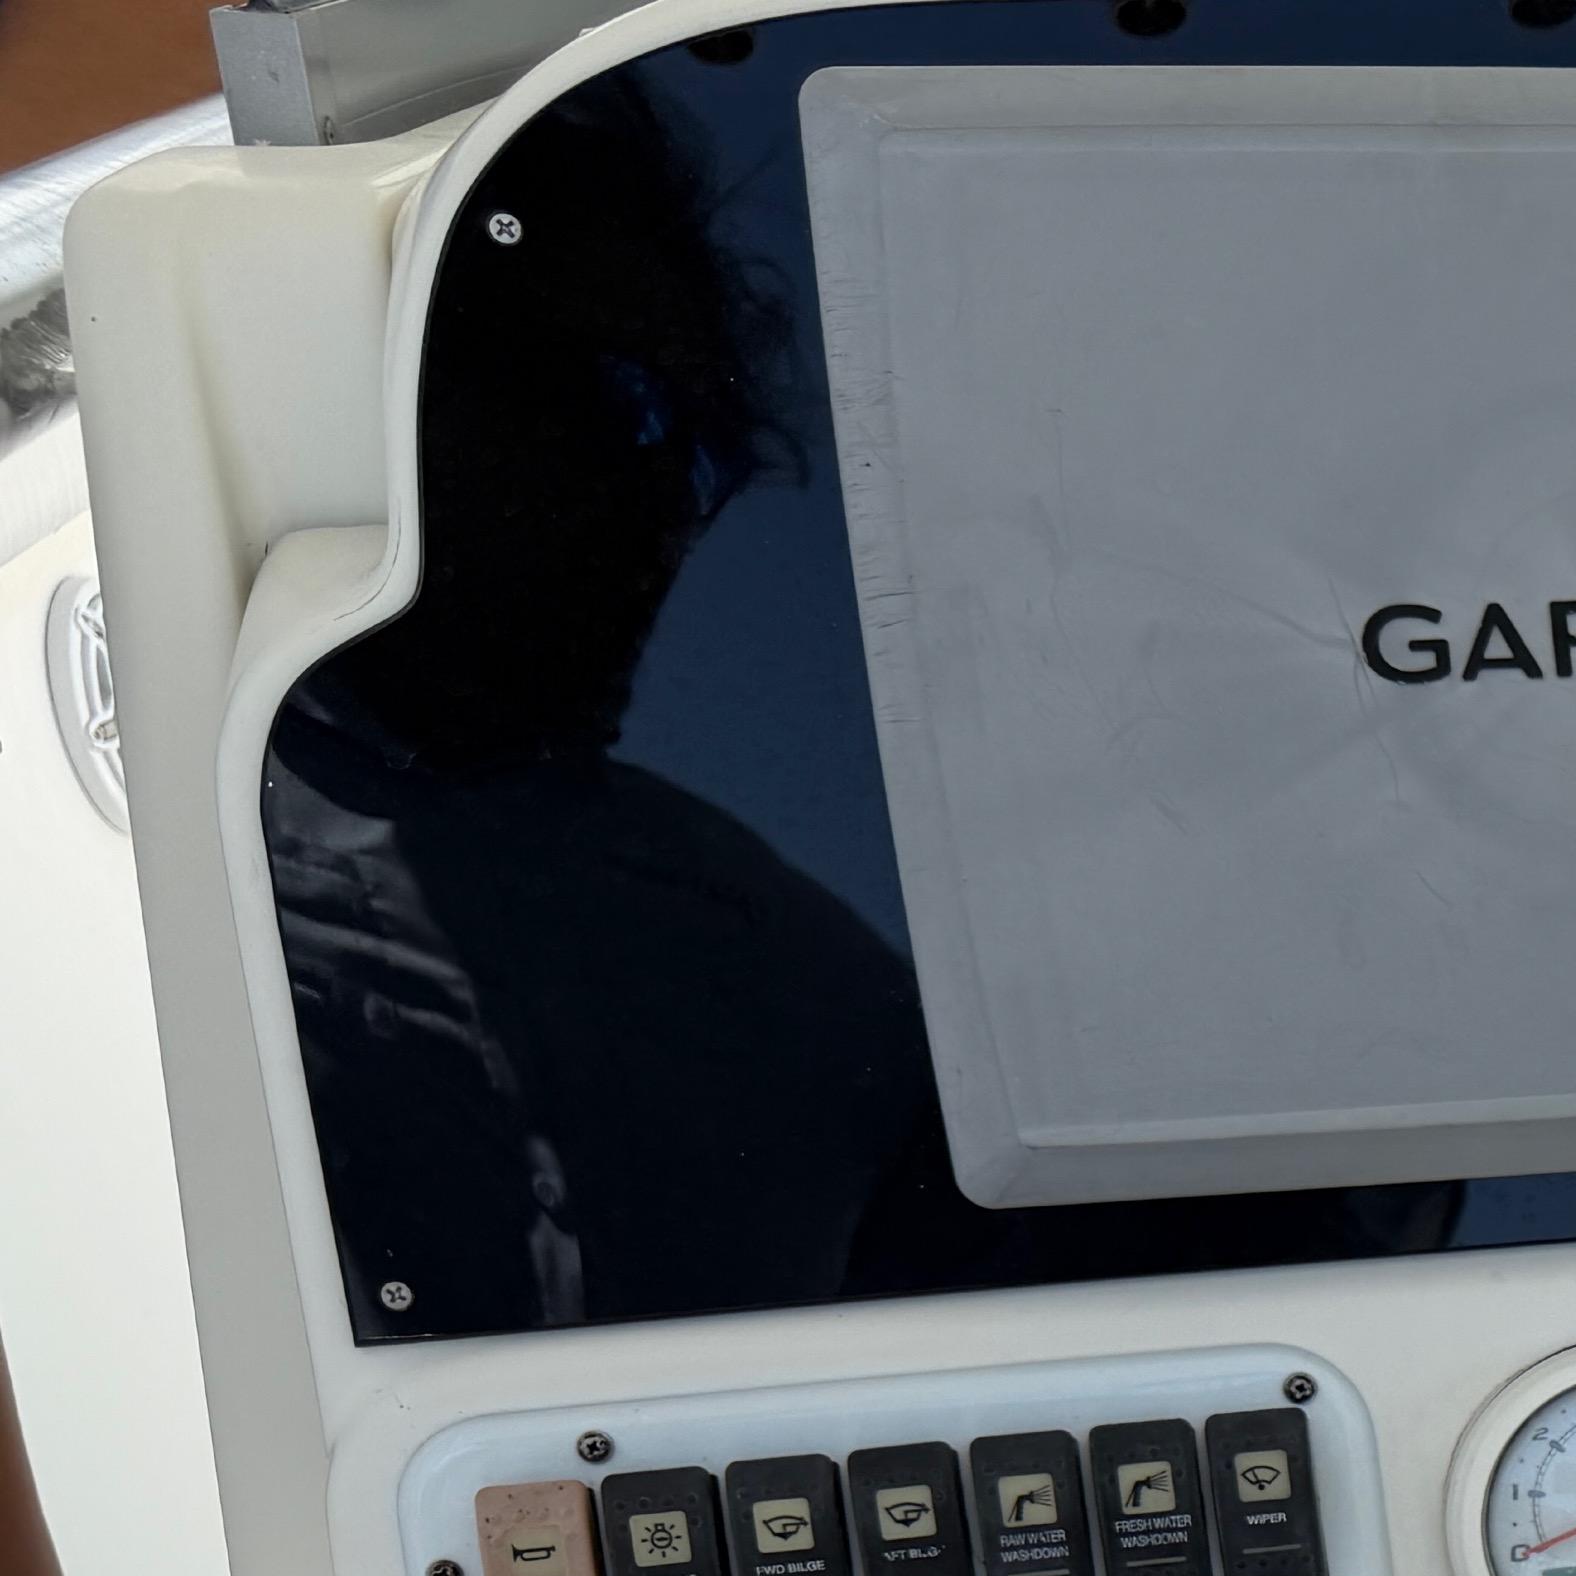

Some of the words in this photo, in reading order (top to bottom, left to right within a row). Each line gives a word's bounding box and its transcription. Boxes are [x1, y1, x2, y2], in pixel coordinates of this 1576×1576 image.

[1531, 1428, 1549, 1441] 2
[1115, 1518, 1151, 1533] FRESH
[1152, 1514, 1192, 1529] WATER
[1247, 1512, 1287, 1525] WIPER
[1000, 1532, 1027, 1547] RAW
[1028, 1529, 1067, 1545] WATER
[1120, 1531, 1188, 1548] WASHDOWN
[1000, 1546, 1069, 1562] WASHDOWN
[1510, 1544, 1530, 1563] 0
[756, 1564, 785, 1576] FWD
[788, 1560, 826, 1573] BILGE
